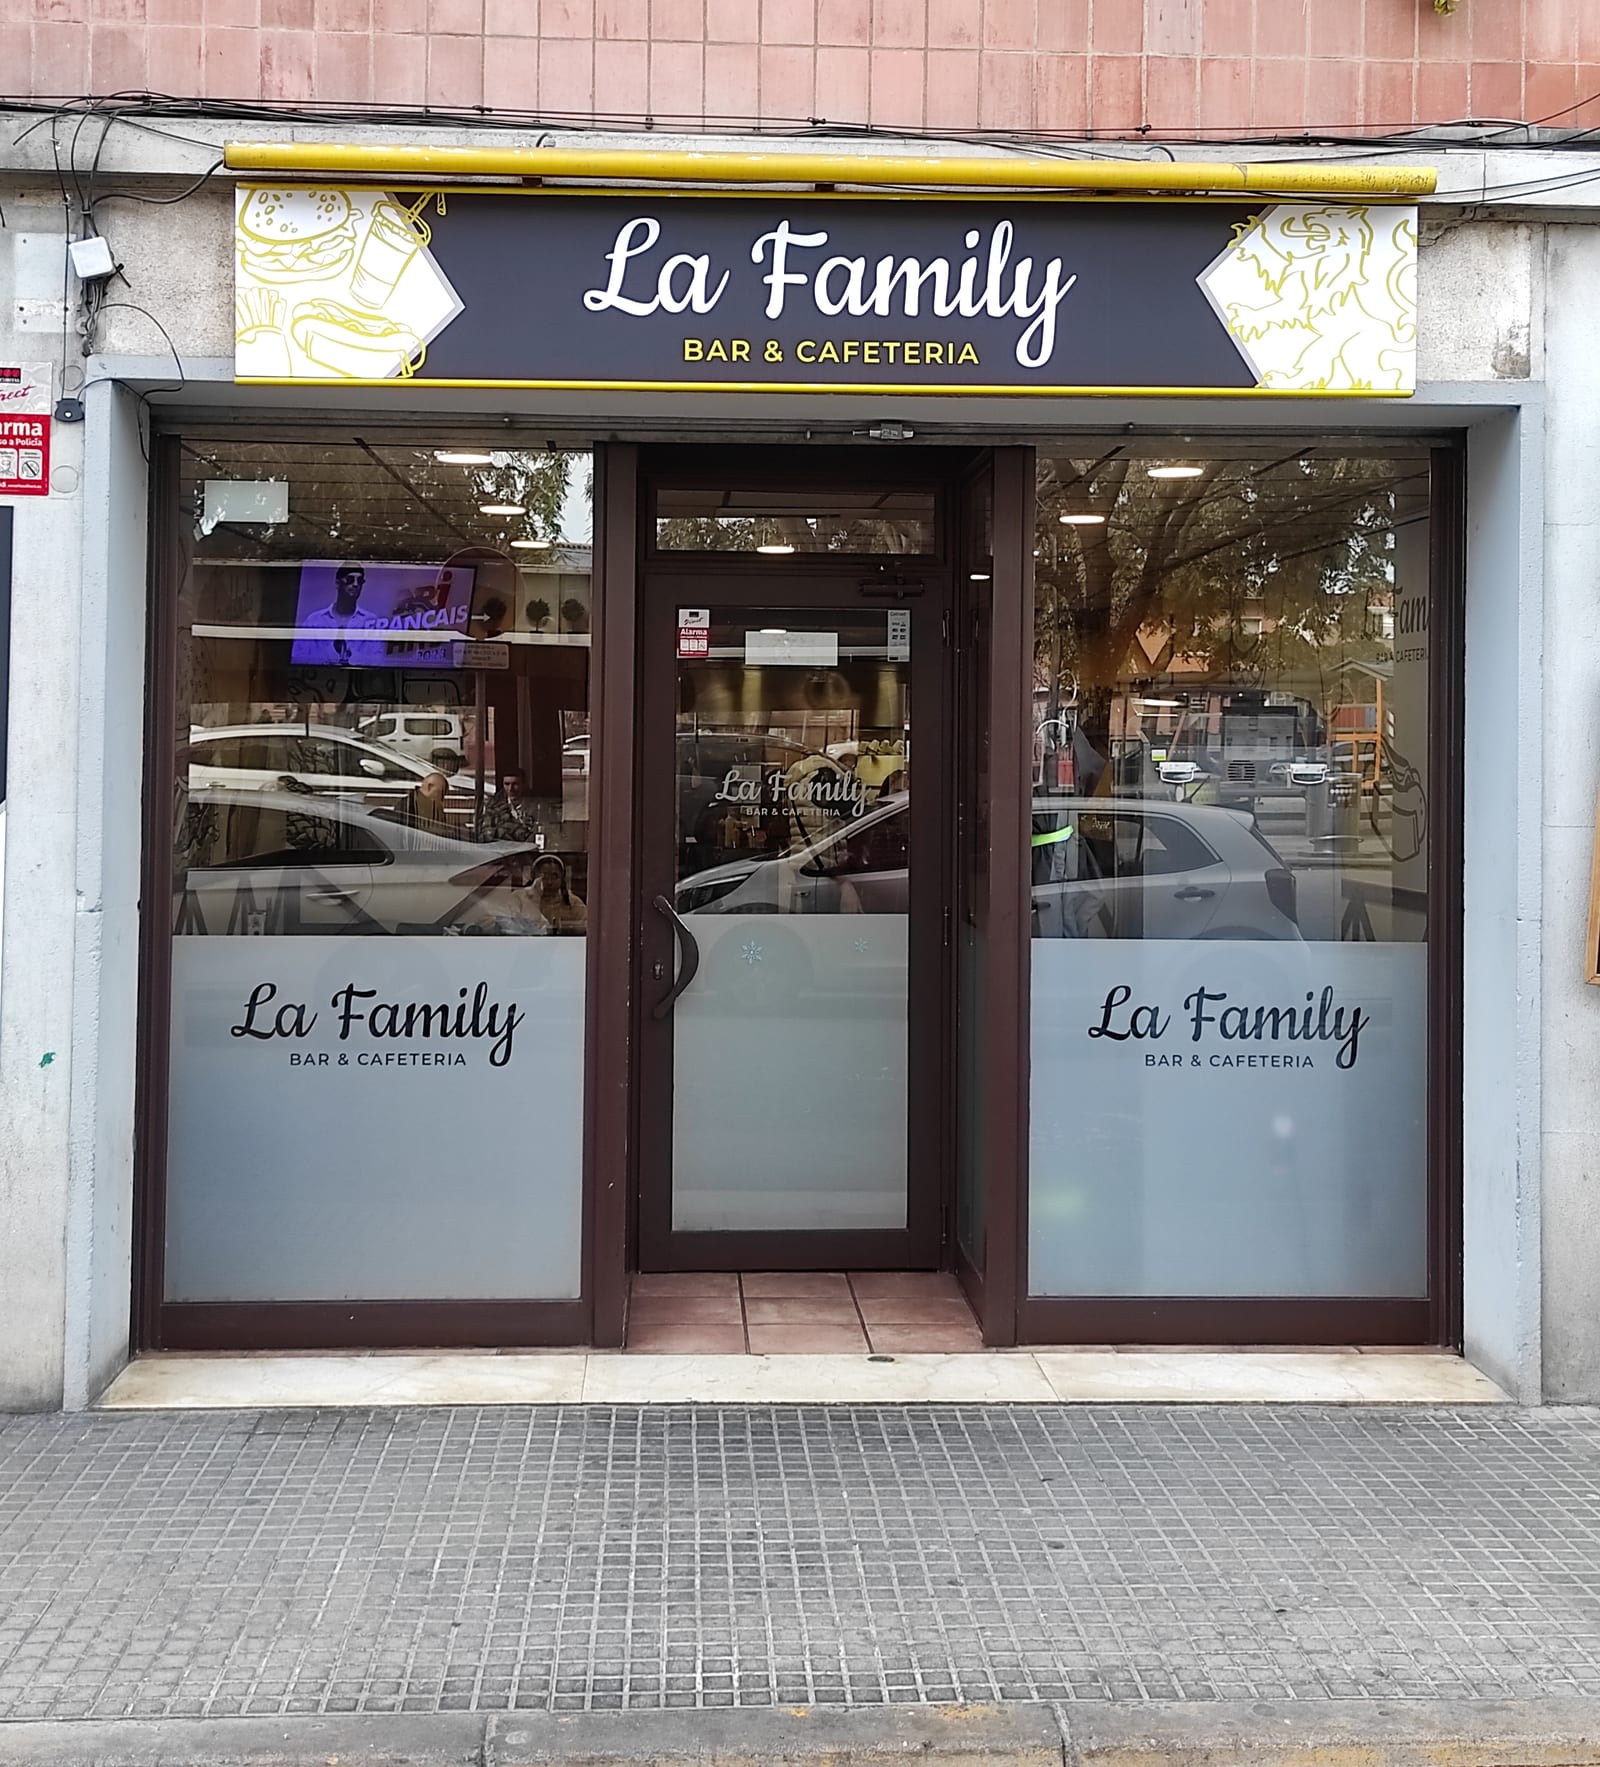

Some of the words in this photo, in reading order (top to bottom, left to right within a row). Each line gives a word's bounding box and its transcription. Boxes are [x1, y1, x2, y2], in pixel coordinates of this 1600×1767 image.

[583, 217, 730, 317] La
[751, 219, 1077, 368] Family
[683, 339, 750, 363] BAR
[763, 340, 784, 363] &
[796, 341, 980, 365] CAFETERIA
[0, 421, 43, 437] rma
[715, 770, 761, 801] La
[768, 770, 868, 817] Family
[746, 808, 768, 816] BAR
[771, 808, 779, 816] &
[782, 808, 841, 817] CAFETERIA
[231, 982, 318, 1040] La
[331, 981, 525, 1067] Family
[1088, 985, 1171, 1041] La
[1184, 985, 1370, 1069] Family
[290, 1053, 329, 1066] BAR
[337, 1053, 349, 1066] &
[357, 1053, 467, 1066] CAFETERIA
[1145, 1054, 1182, 1067] BAR
[1190, 1054, 1202, 1067] &
[1209, 1055, 1314, 1068] CAFETERIA
